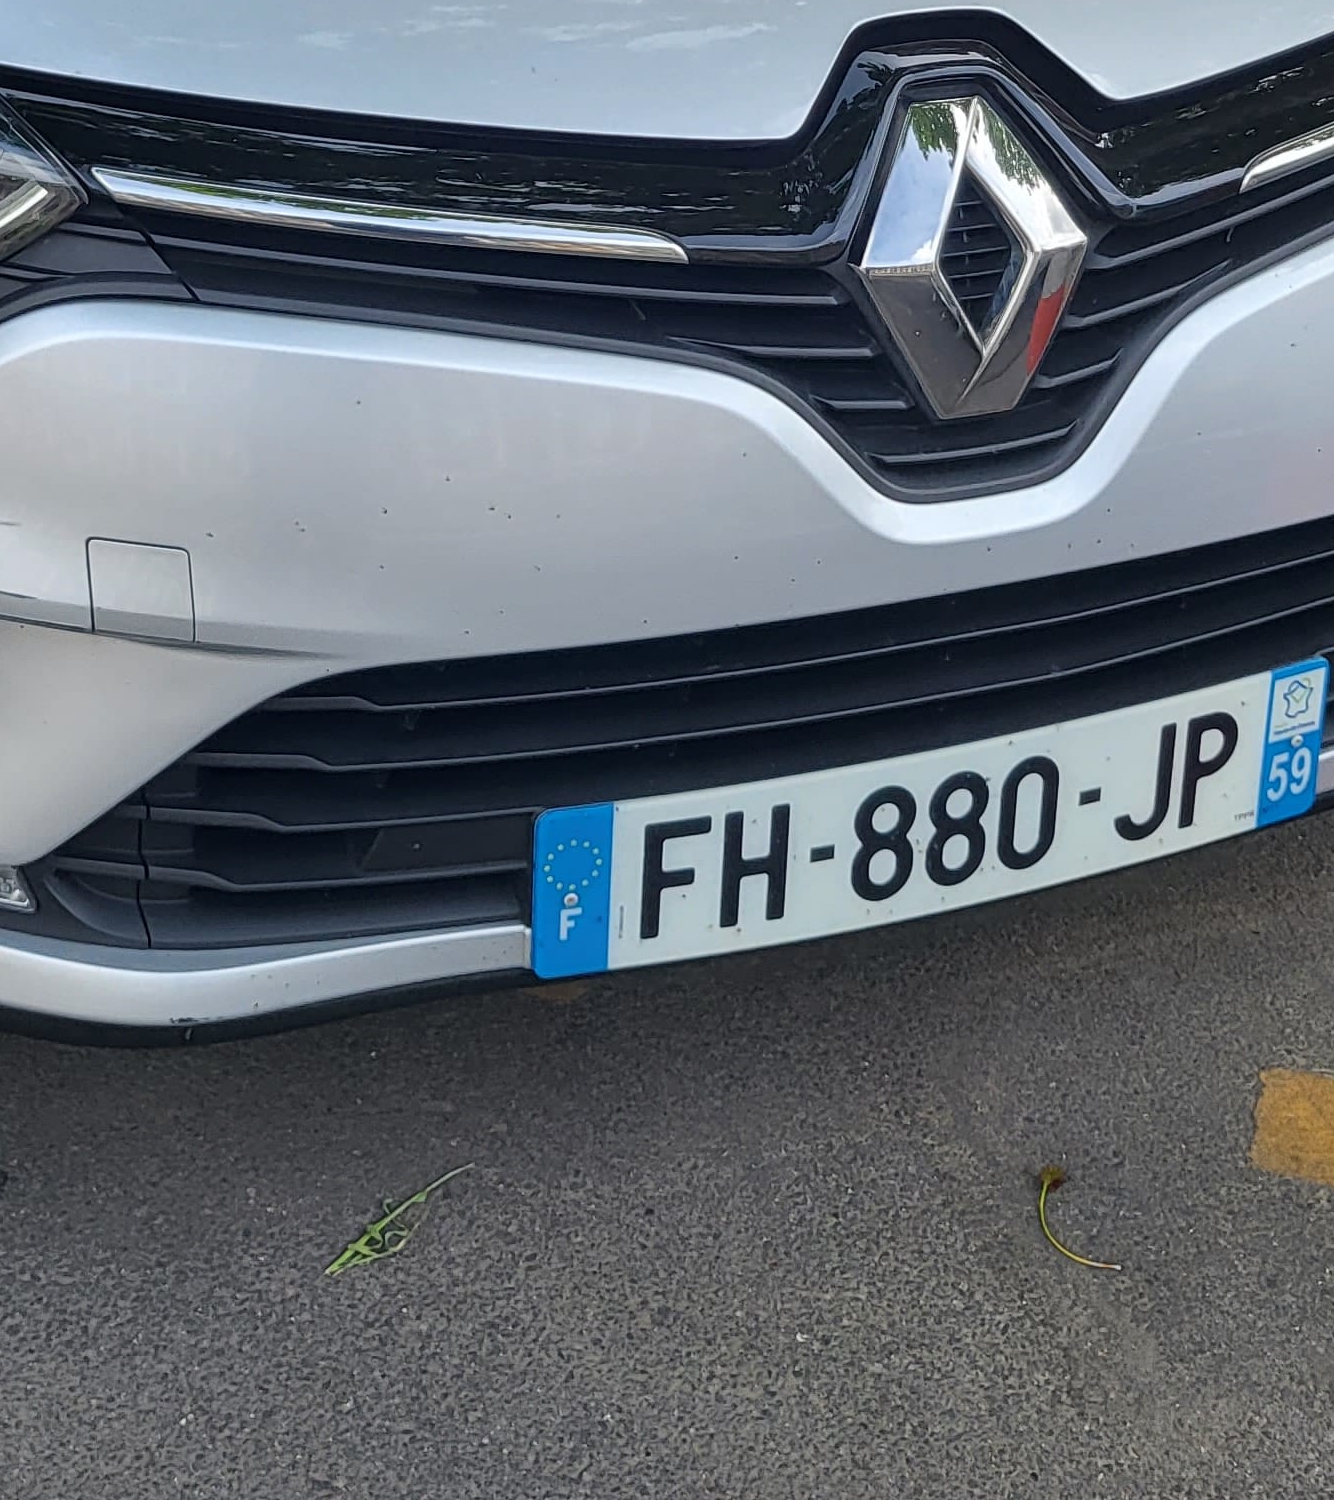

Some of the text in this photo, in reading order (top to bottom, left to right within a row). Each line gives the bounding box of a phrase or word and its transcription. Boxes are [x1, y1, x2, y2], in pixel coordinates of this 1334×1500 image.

[1266, 747, 1312, 802] 59
[639, 711, 1239, 940] FH-880-JP
[559, 907, 583, 941] F
